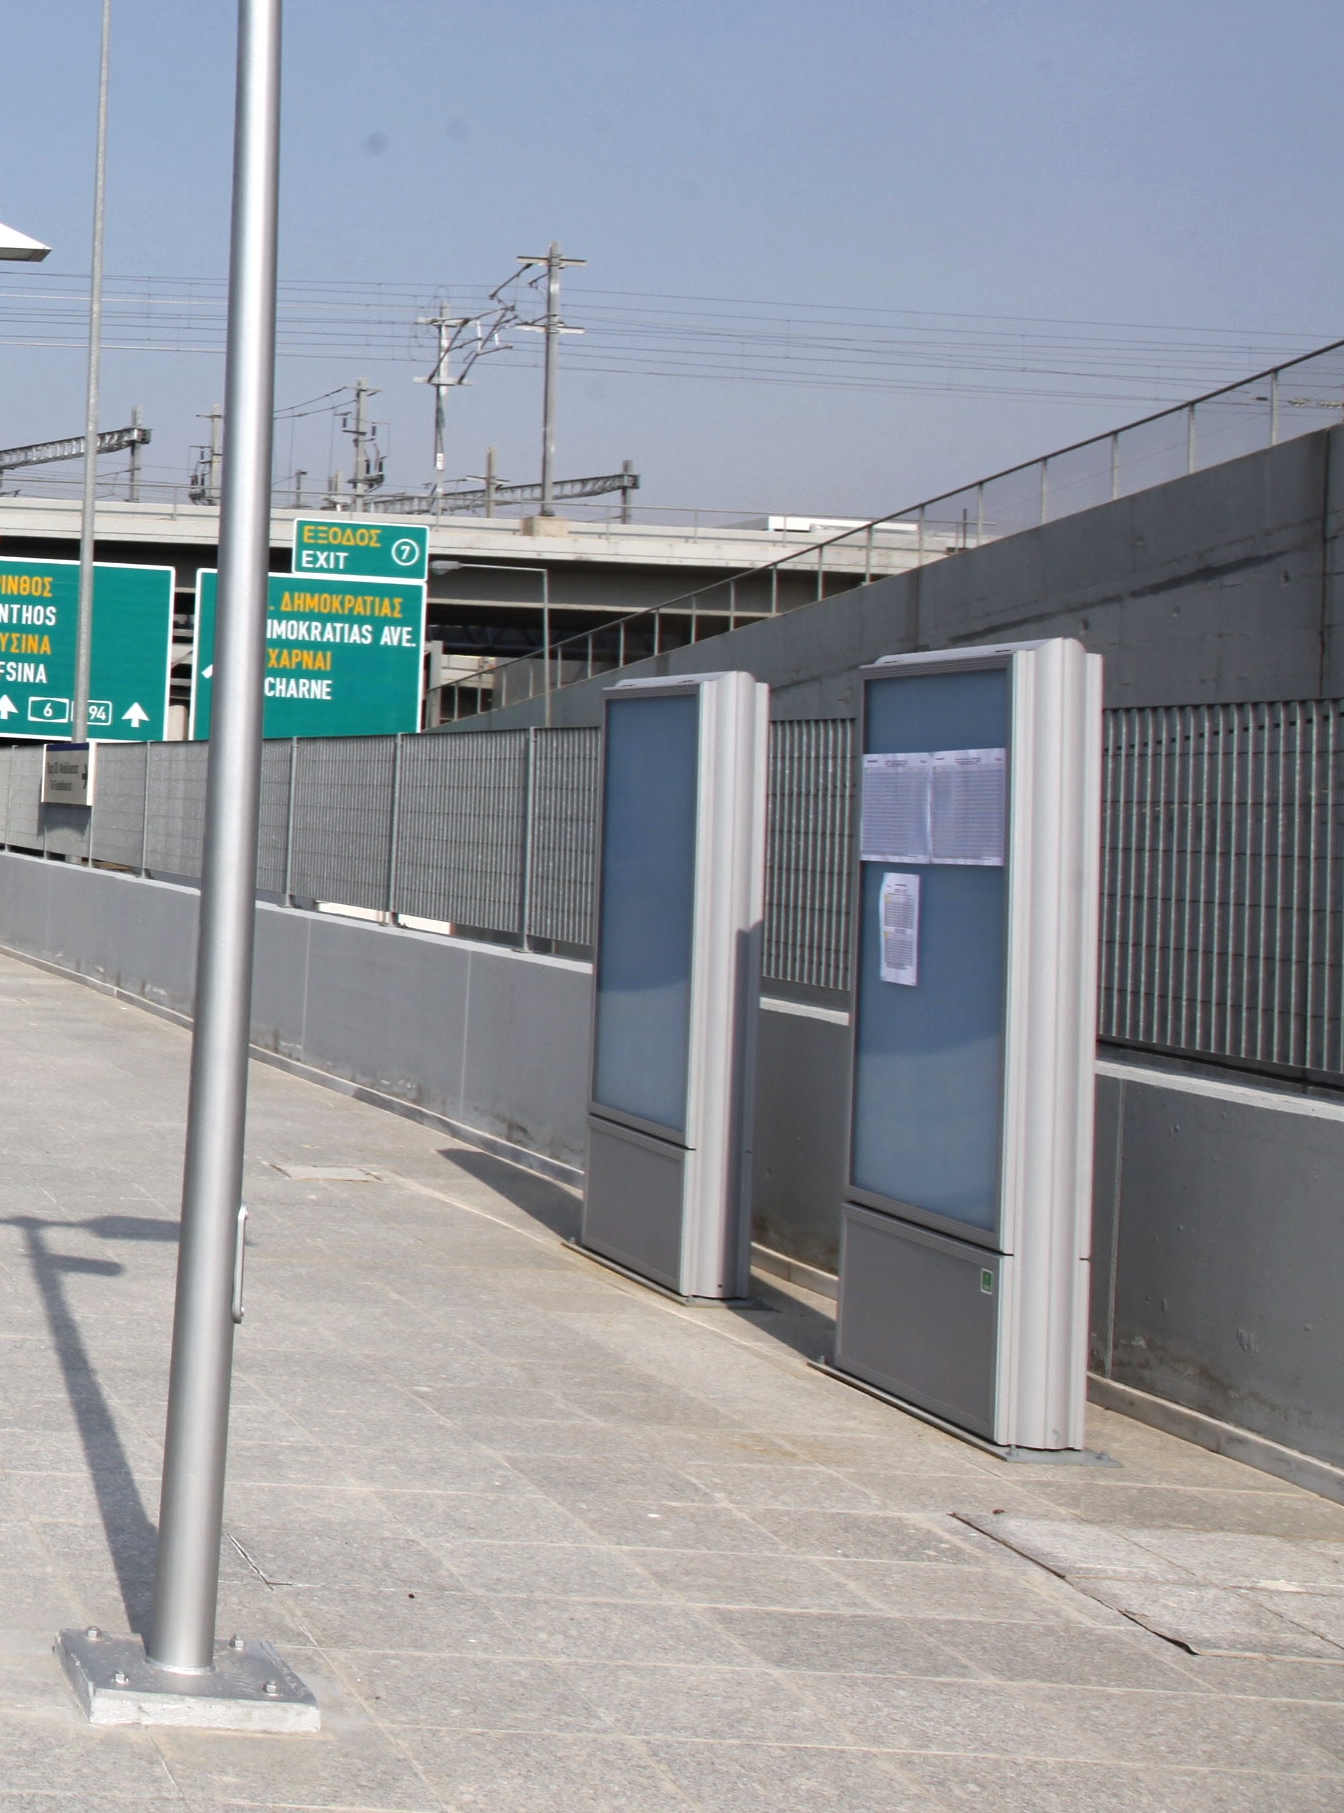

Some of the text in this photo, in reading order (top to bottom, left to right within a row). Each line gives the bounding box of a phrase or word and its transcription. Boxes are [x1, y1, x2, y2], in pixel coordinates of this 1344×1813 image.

[303, 525, 382, 547] ΕΞΟΔΟΣ
[301, 549, 349, 570] EXIT
[400, 545, 410, 560] 7
[280, 591, 403, 618] ΔΗΜΟΚΡΑΤΙΑΣ
[266, 618, 417, 647] IMOKRATIAS AVE.
[267, 648, 332, 671] ΧΑΡΝΑΙ
[264, 676, 333, 700] CHARNE
[43, 702, 53, 717] 6
[88, 705, 106, 720] 94
